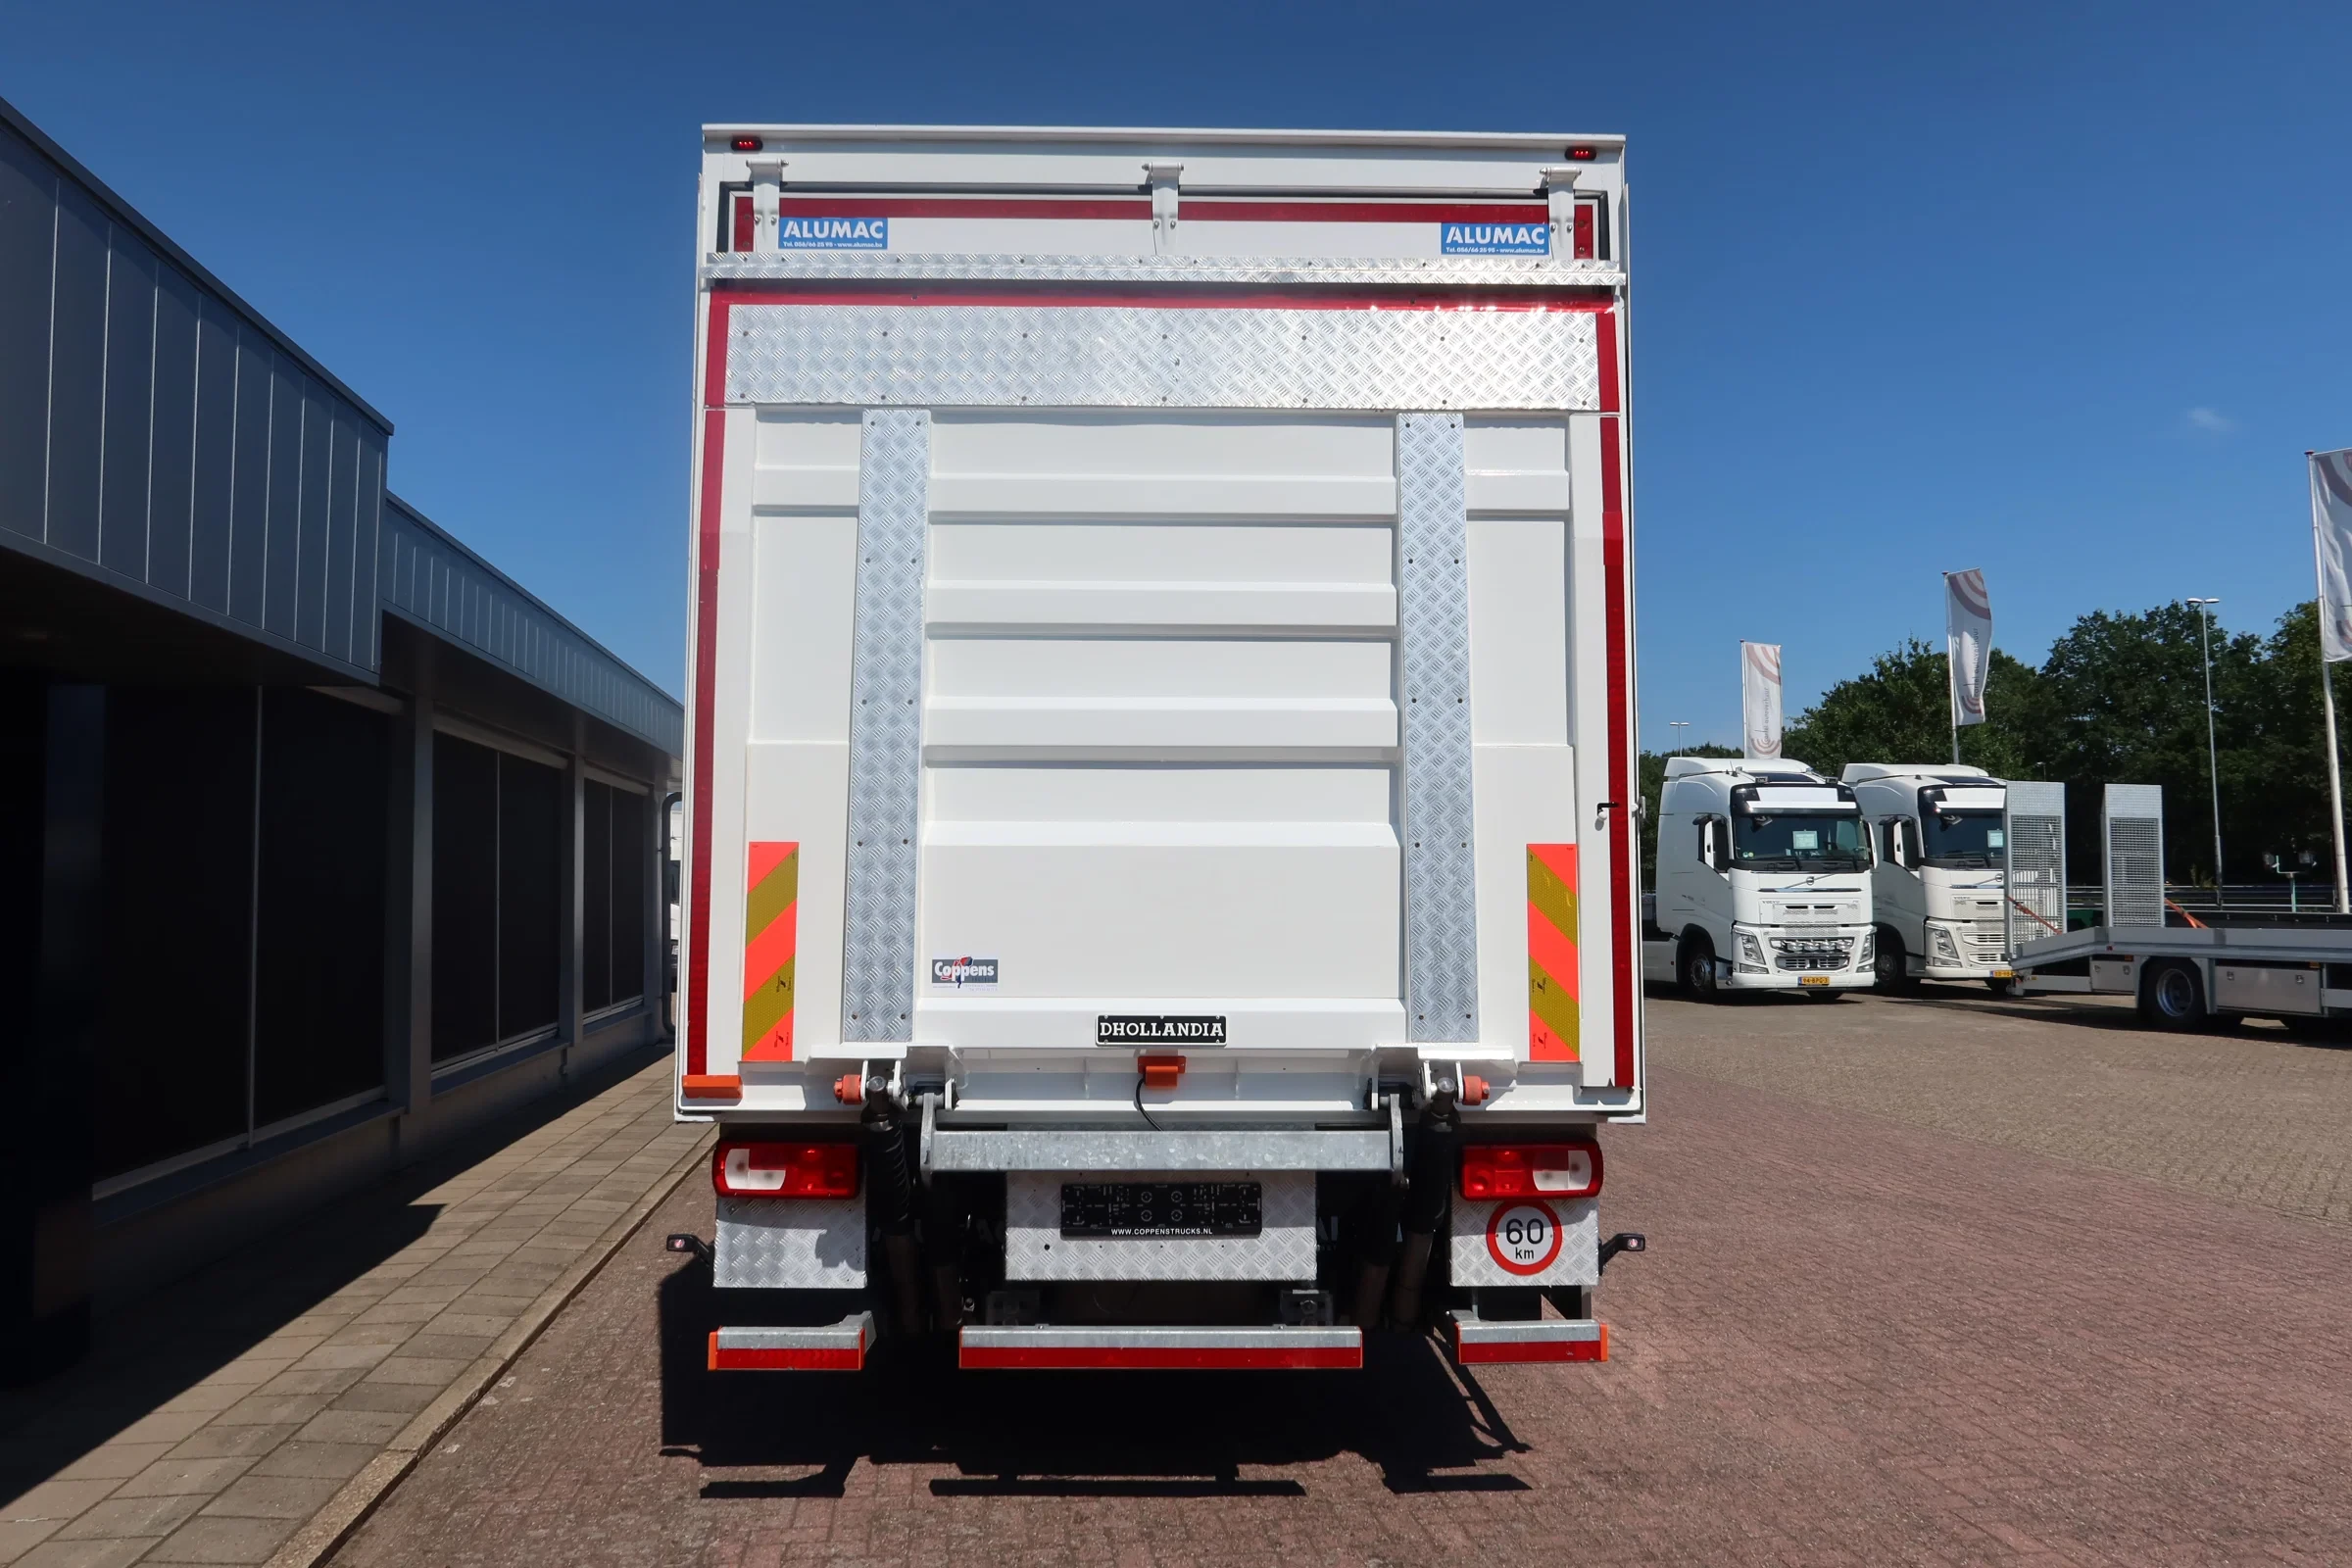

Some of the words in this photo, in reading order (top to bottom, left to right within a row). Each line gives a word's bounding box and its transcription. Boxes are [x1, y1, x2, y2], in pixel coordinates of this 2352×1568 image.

[783, 220, 884, 239] ALUMAC
[1446, 226, 1545, 245] ALUMAC
[934, 961, 995, 981] Coppens
[1100, 1022, 1224, 1037] DHOLLANDIA
[1110, 1227, 1213, 1236] WWW.COPPENSTRUCKS.NL
[1505, 1218, 1544, 1246] 60
[1515, 1247, 1535, 1260] km
